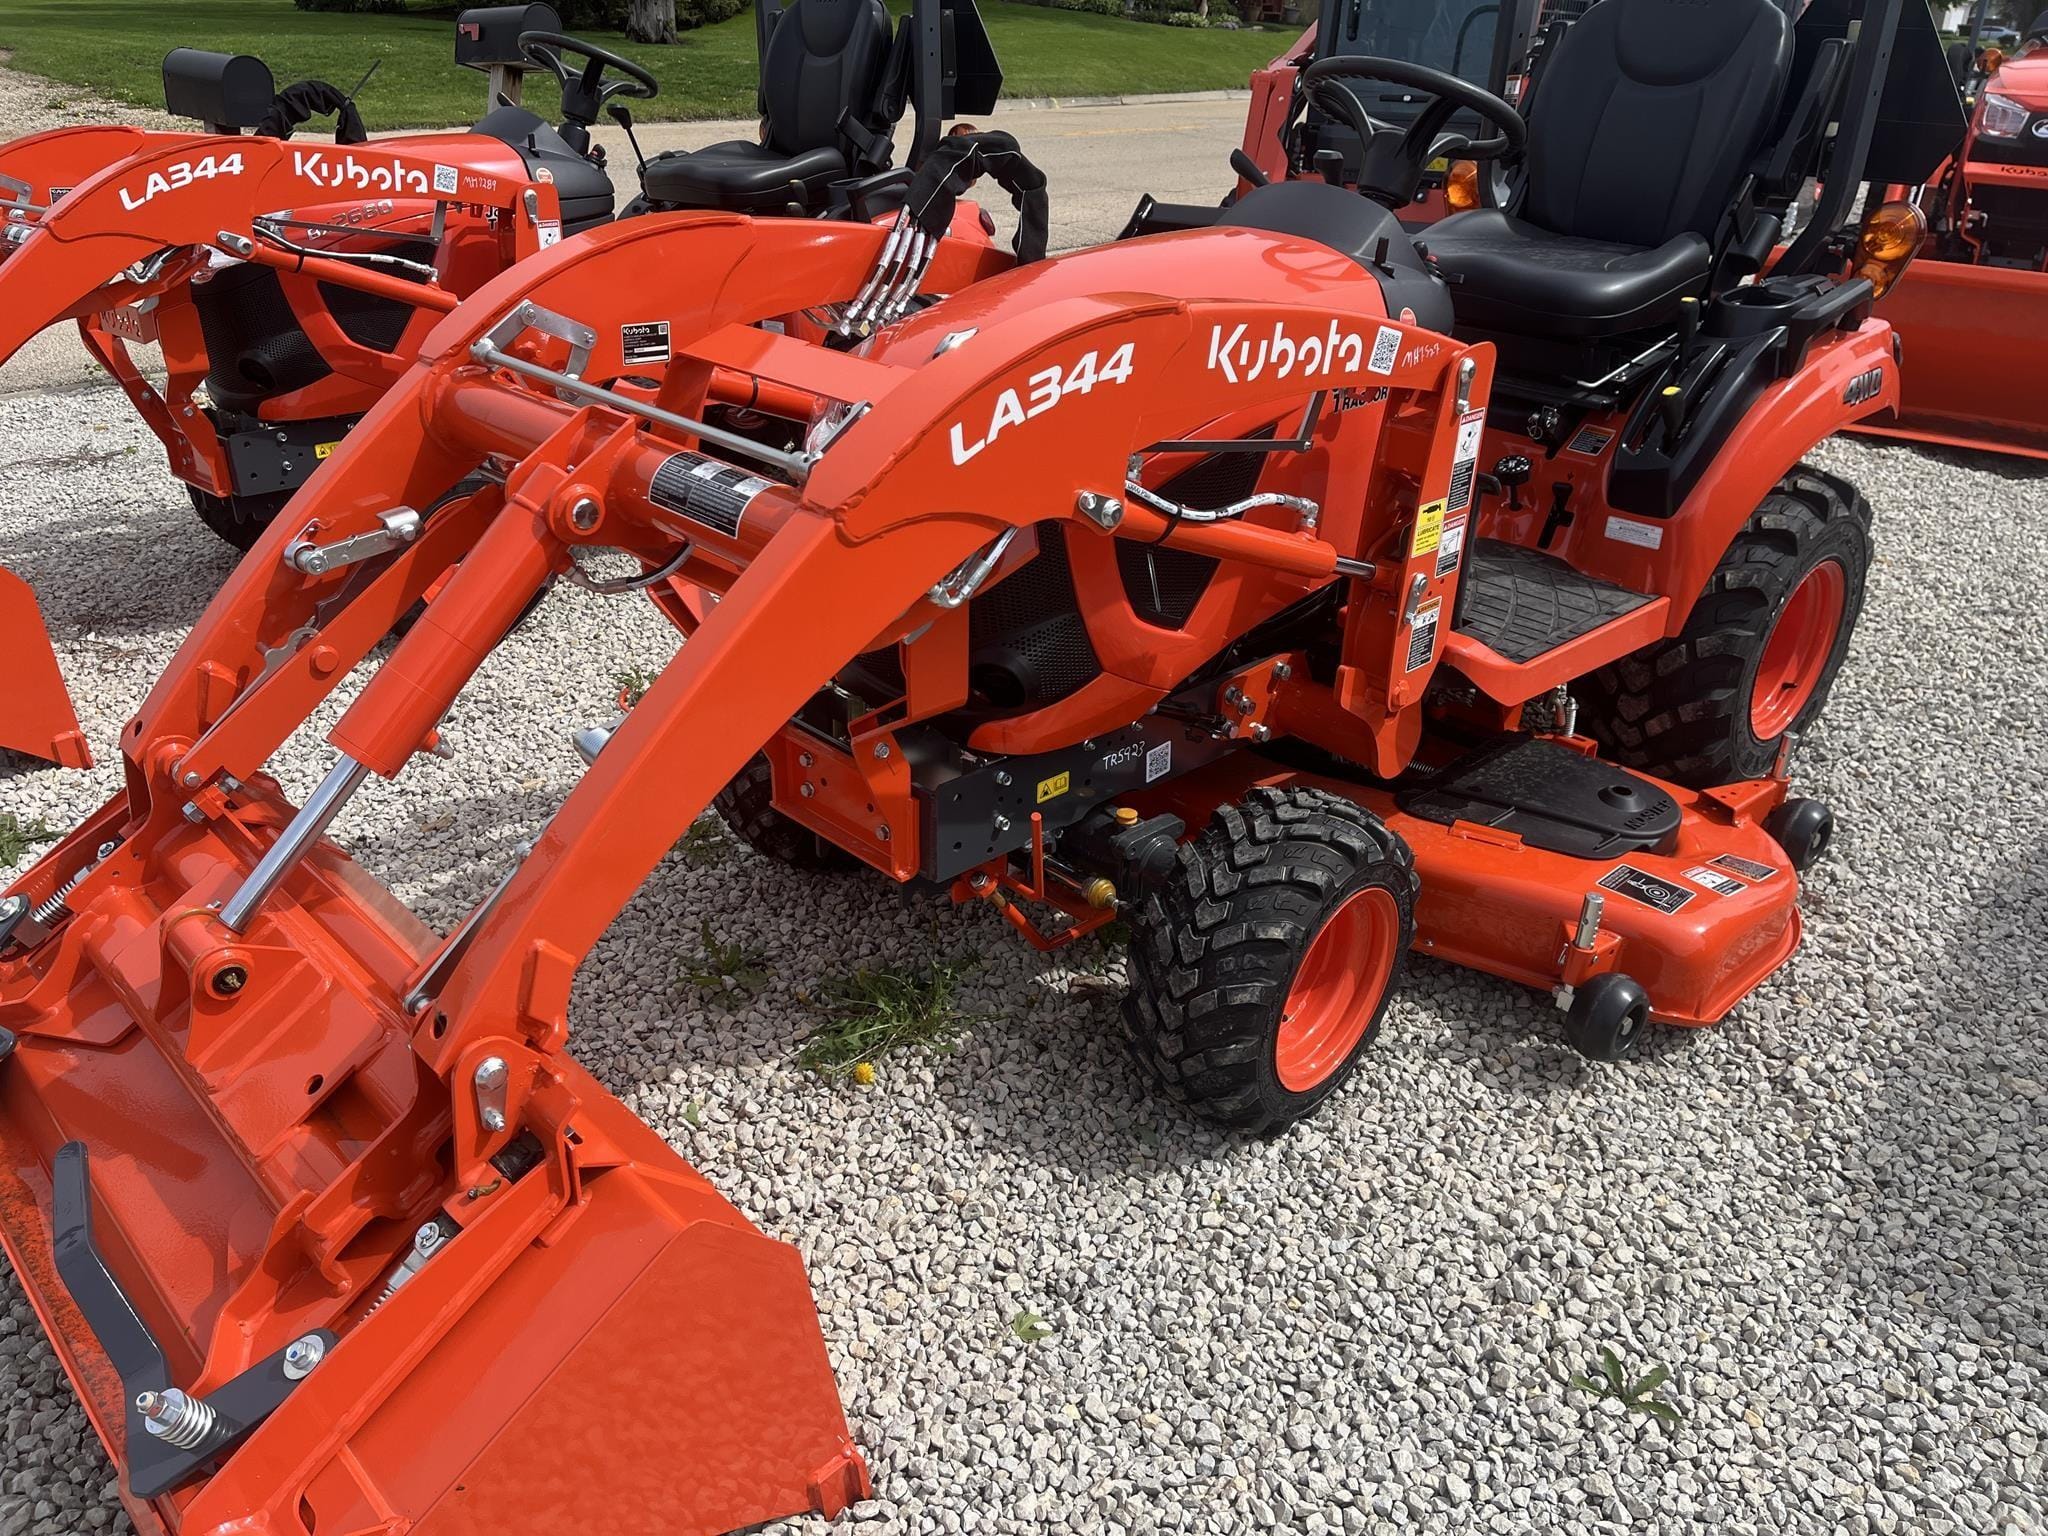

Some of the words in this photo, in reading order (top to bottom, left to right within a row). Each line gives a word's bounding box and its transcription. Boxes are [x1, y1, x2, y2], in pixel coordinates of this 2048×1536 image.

[118, 153, 244, 211] LA344
[294, 151, 428, 193] Kubota
[623, 326, 650, 335] Kubota
[1207, 319, 1363, 383] Kubota
[950, 342, 1135, 466] LA344
[1102, 741, 1146, 770] TR5923
